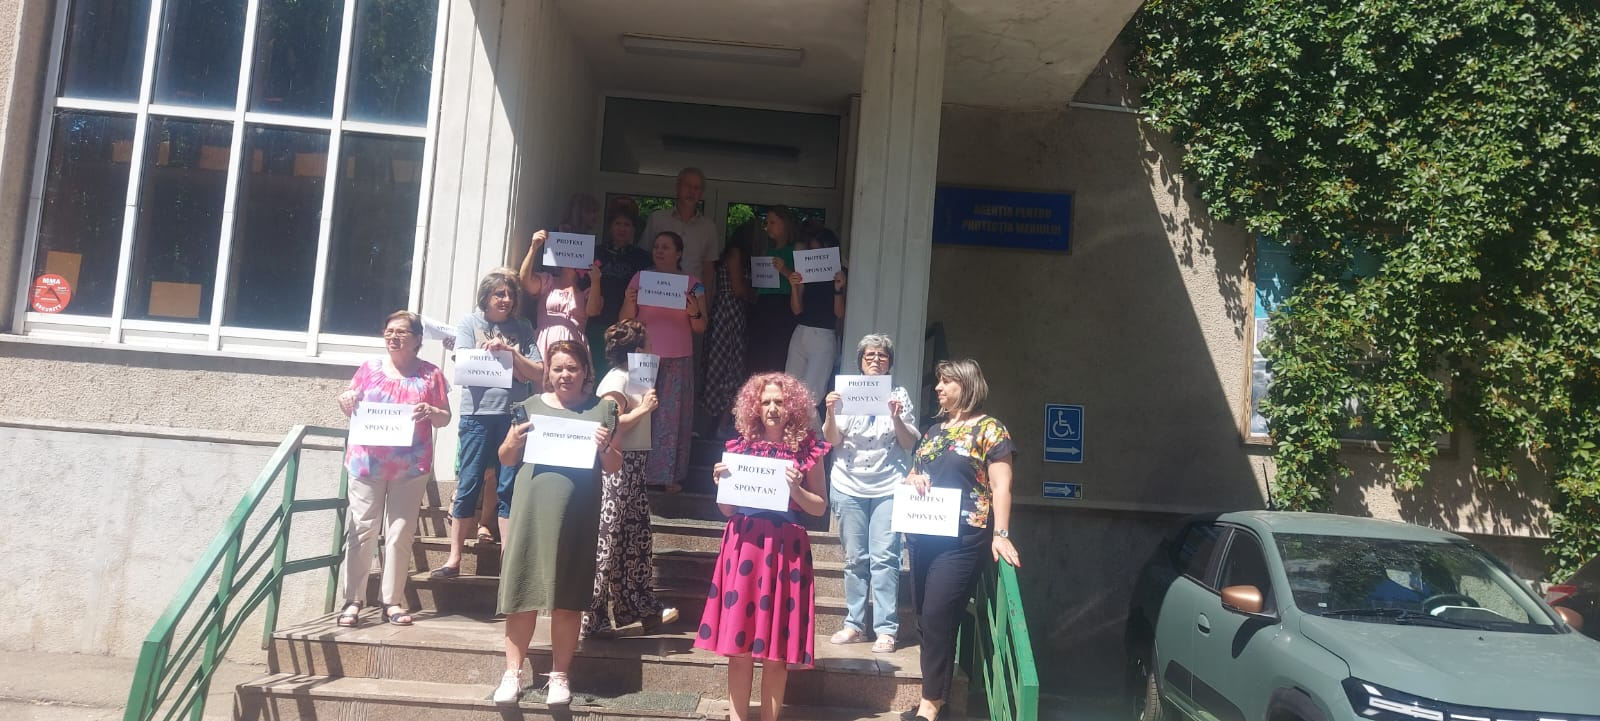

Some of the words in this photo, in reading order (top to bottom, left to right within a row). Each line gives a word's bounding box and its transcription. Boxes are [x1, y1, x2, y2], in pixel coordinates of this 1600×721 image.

[556, 238, 584, 247] PROTEST
[804, 254, 829, 262] PROTEST
[35, 302, 61, 312] SECURITY
[467, 369, 502, 377] SPONTAN!
[367, 408, 401, 416] PROTEST
[542, 431, 566, 439] PROTEST
[567, 433, 592, 441] SPONTAN
[737, 464, 777, 476] PROTEST
[734, 483, 777, 496] SPONTAN!
[910, 494, 944, 504] PROTEST
[907, 512, 947, 522] SPONTAN!
